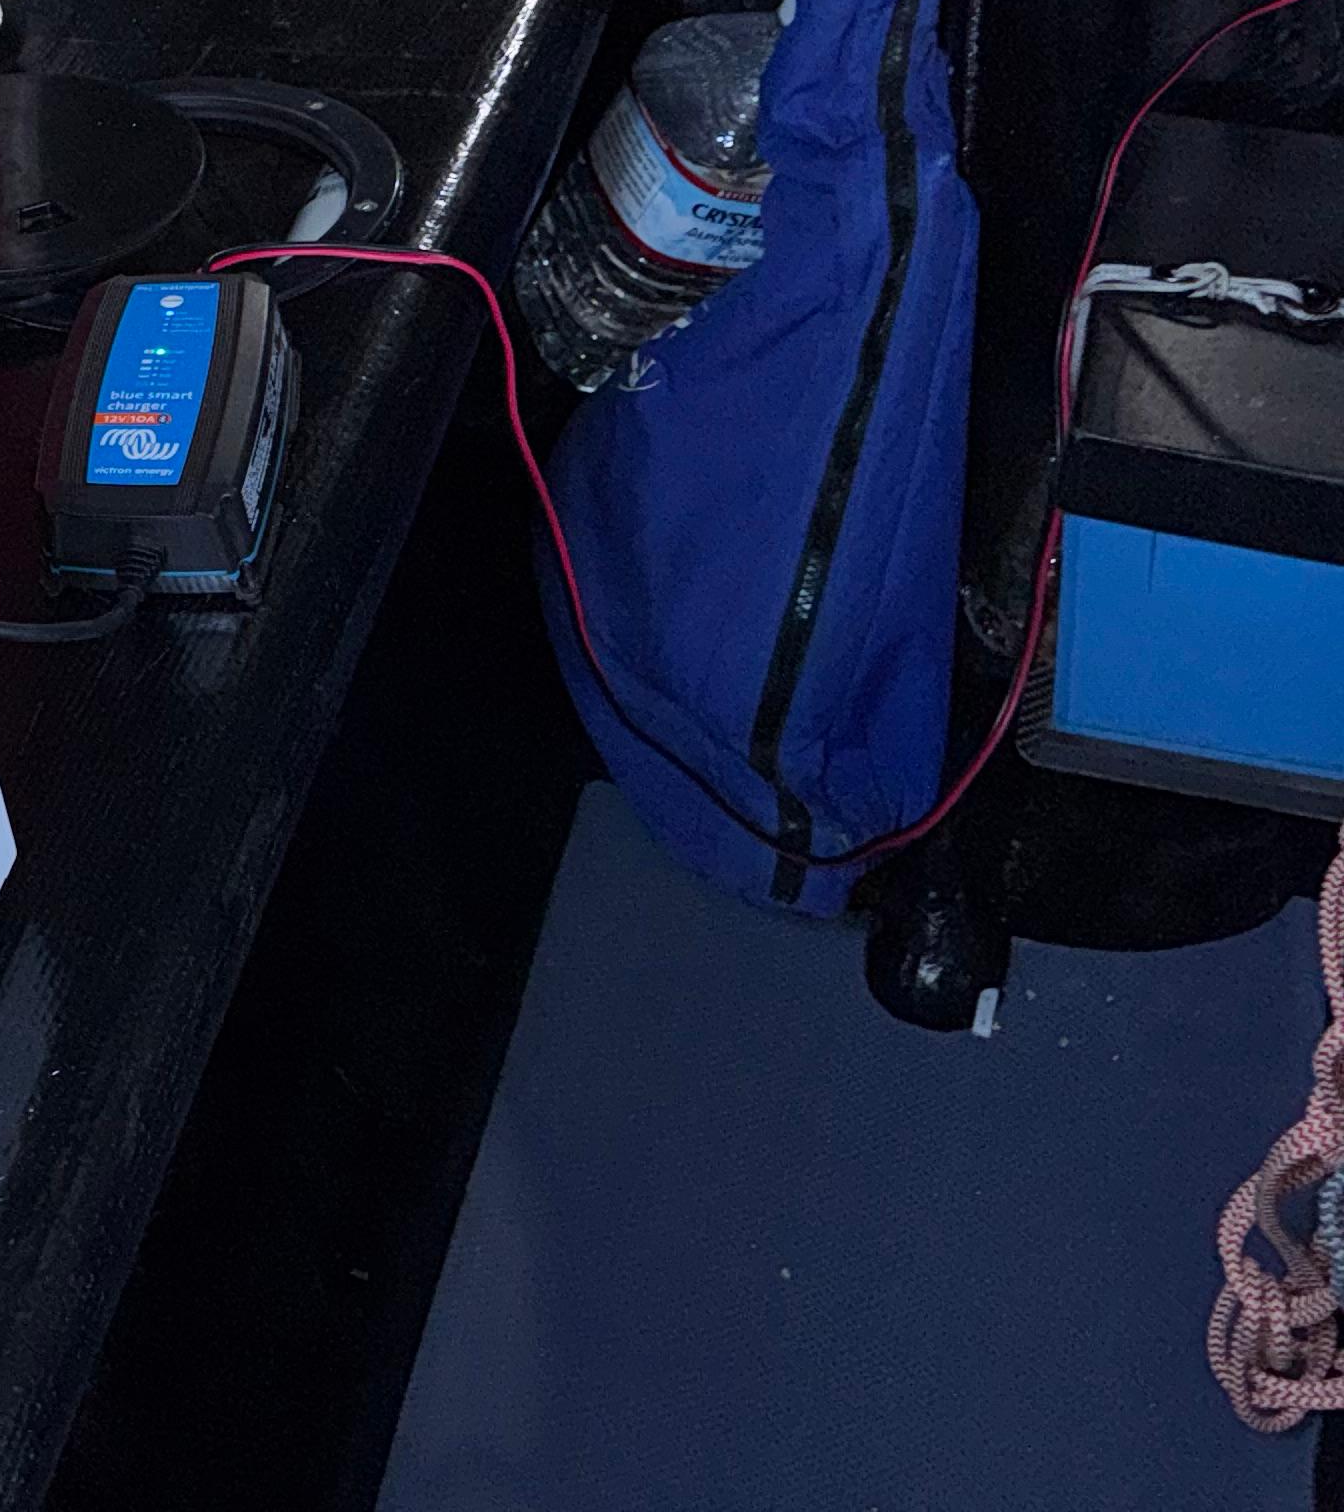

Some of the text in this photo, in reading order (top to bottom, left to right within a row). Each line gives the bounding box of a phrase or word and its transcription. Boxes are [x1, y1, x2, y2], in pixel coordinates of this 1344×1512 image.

[110, 391, 193, 400] blue smart
[107, 400, 168, 413] charger
[94, 466, 174, 477] victron energy
